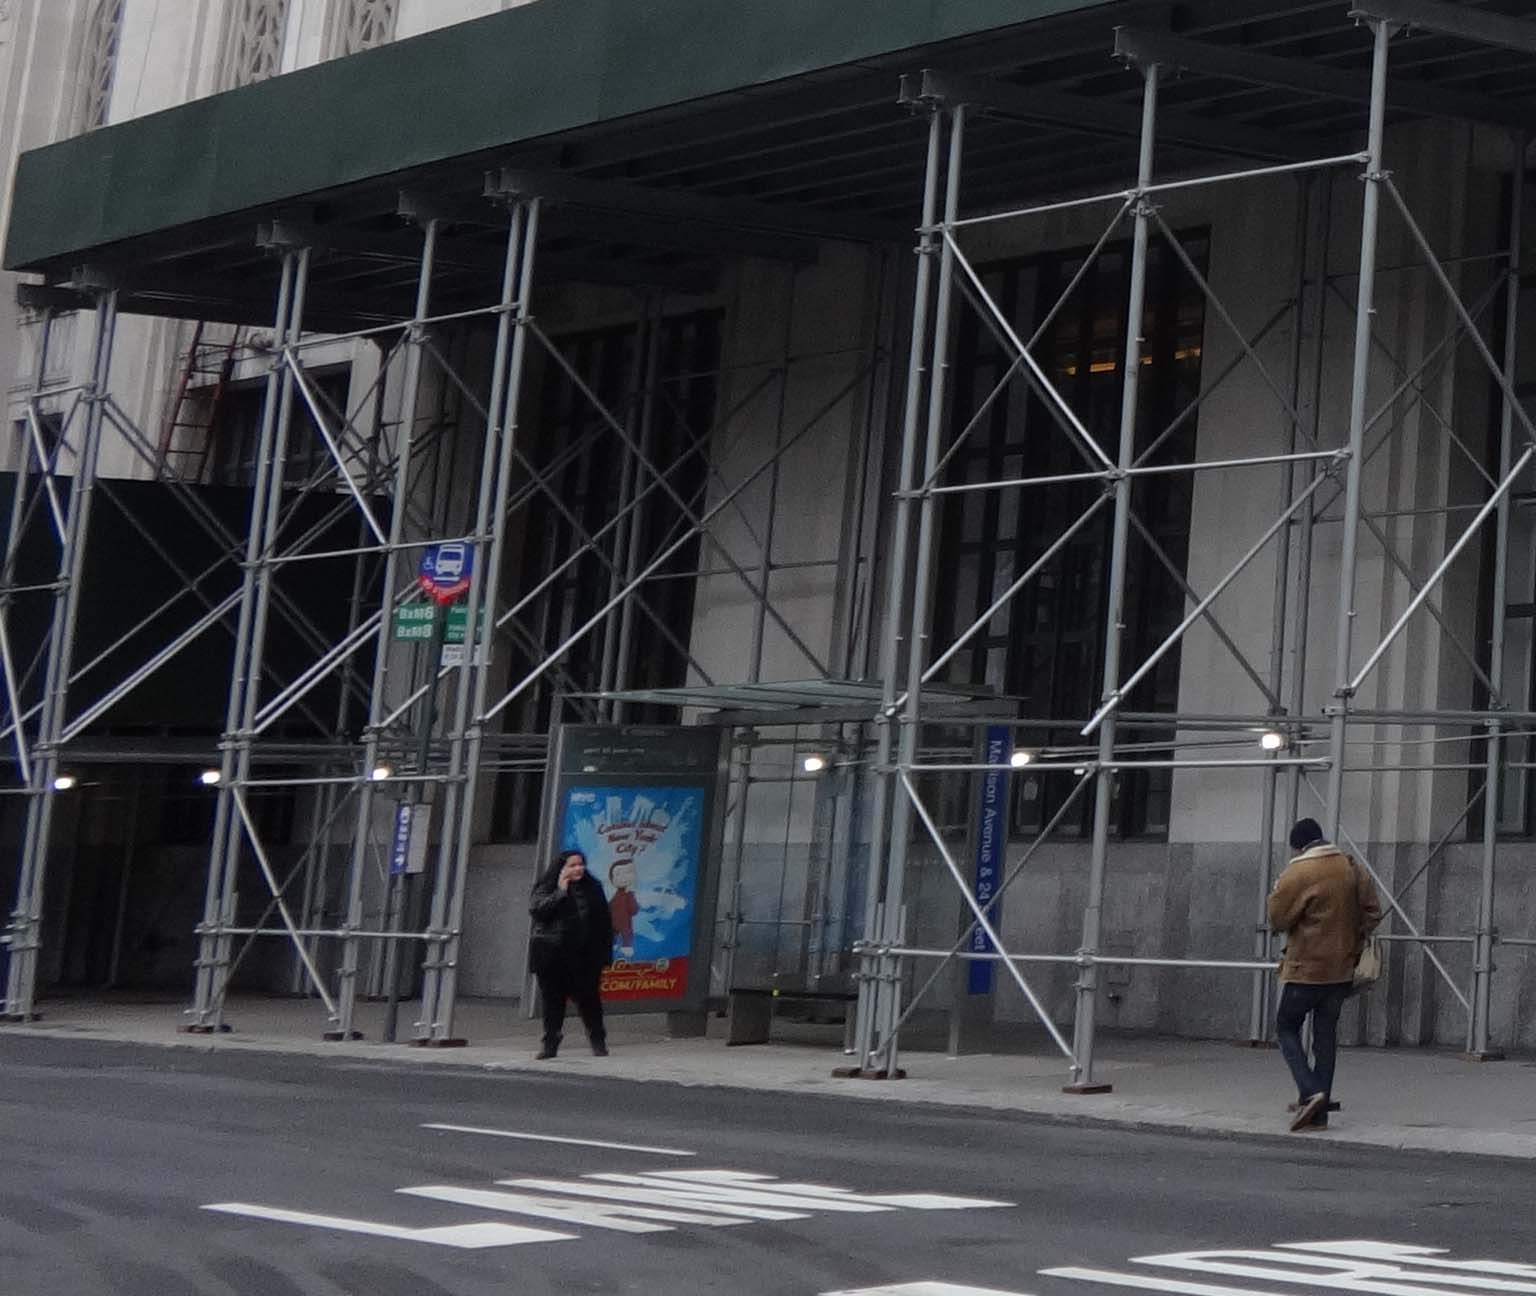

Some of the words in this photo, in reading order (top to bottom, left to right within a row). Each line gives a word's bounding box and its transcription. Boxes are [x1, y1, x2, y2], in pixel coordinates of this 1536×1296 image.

[399, 606, 434, 620] BxM6
[986, 740, 1002, 804] Maison
[979, 808, 997, 863] Avenue
[980, 867, 993, 878] &
[978, 883, 992, 901] 24
